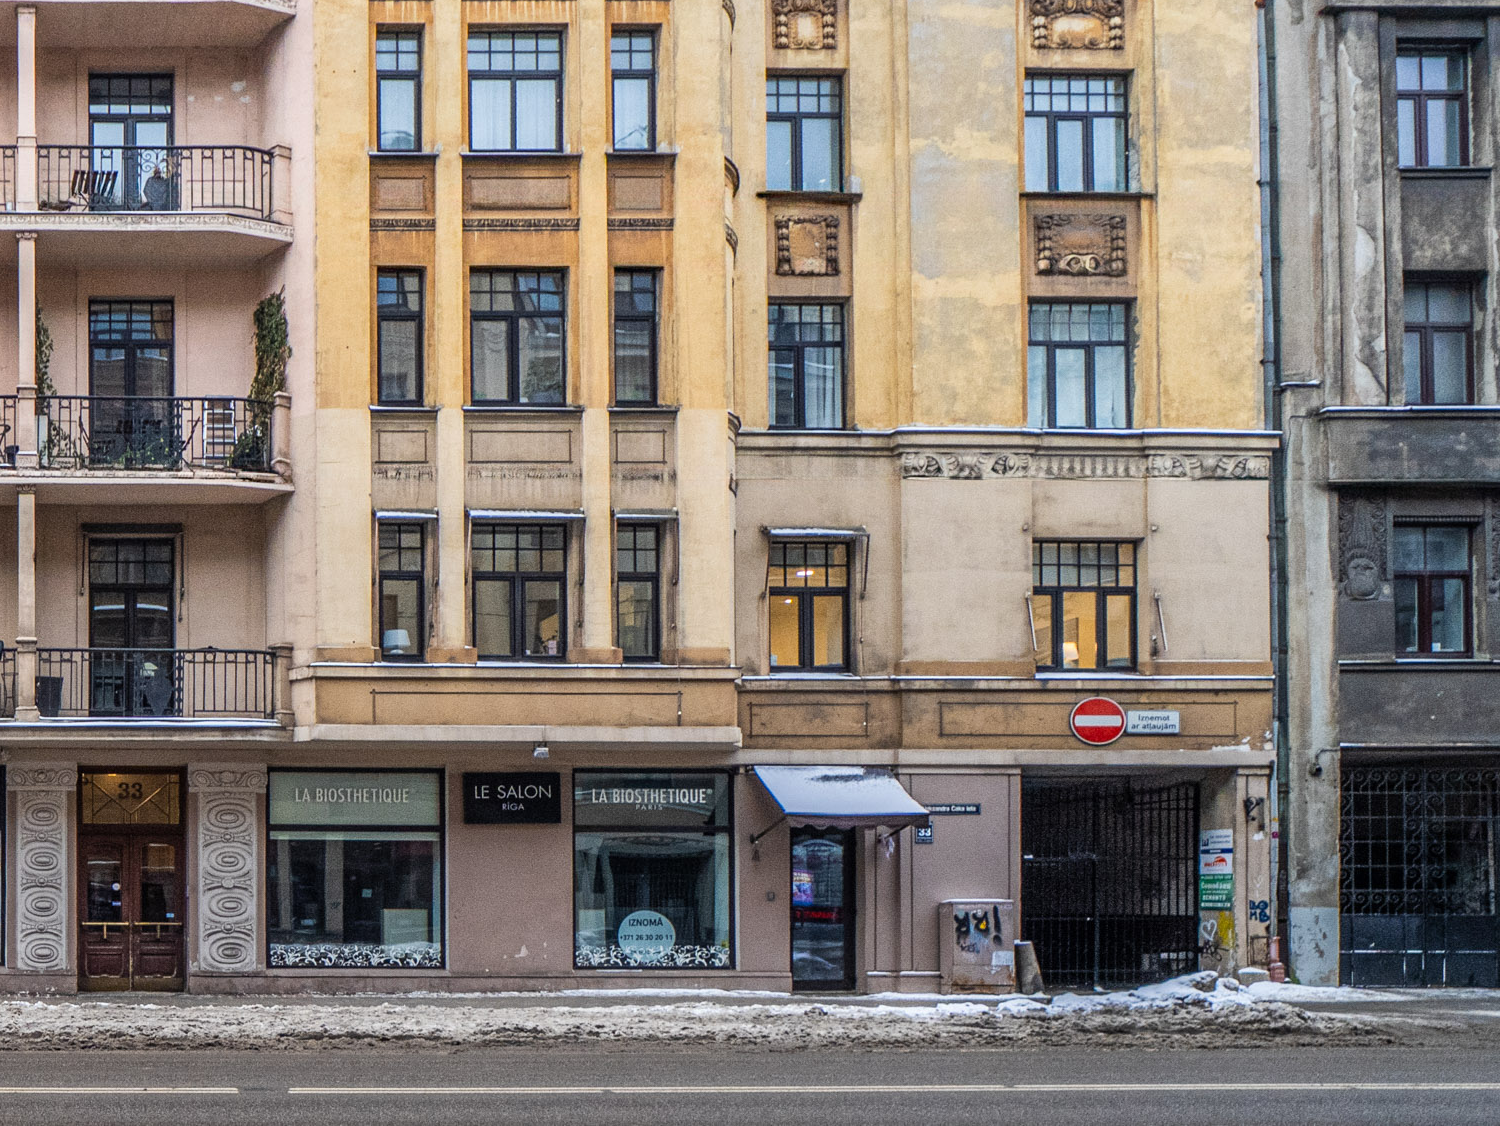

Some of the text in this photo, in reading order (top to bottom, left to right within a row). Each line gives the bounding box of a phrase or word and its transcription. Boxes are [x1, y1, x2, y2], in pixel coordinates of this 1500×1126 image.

[118, 782, 143, 800] 33
[295, 788, 410, 804] LA BIOSTHETIQUE
[474, 785, 552, 800] LE SALON
[592, 788, 608, 804] LA
[918, 827, 932, 837] 33
[628, 917, 664, 927] IZNOMĀ
